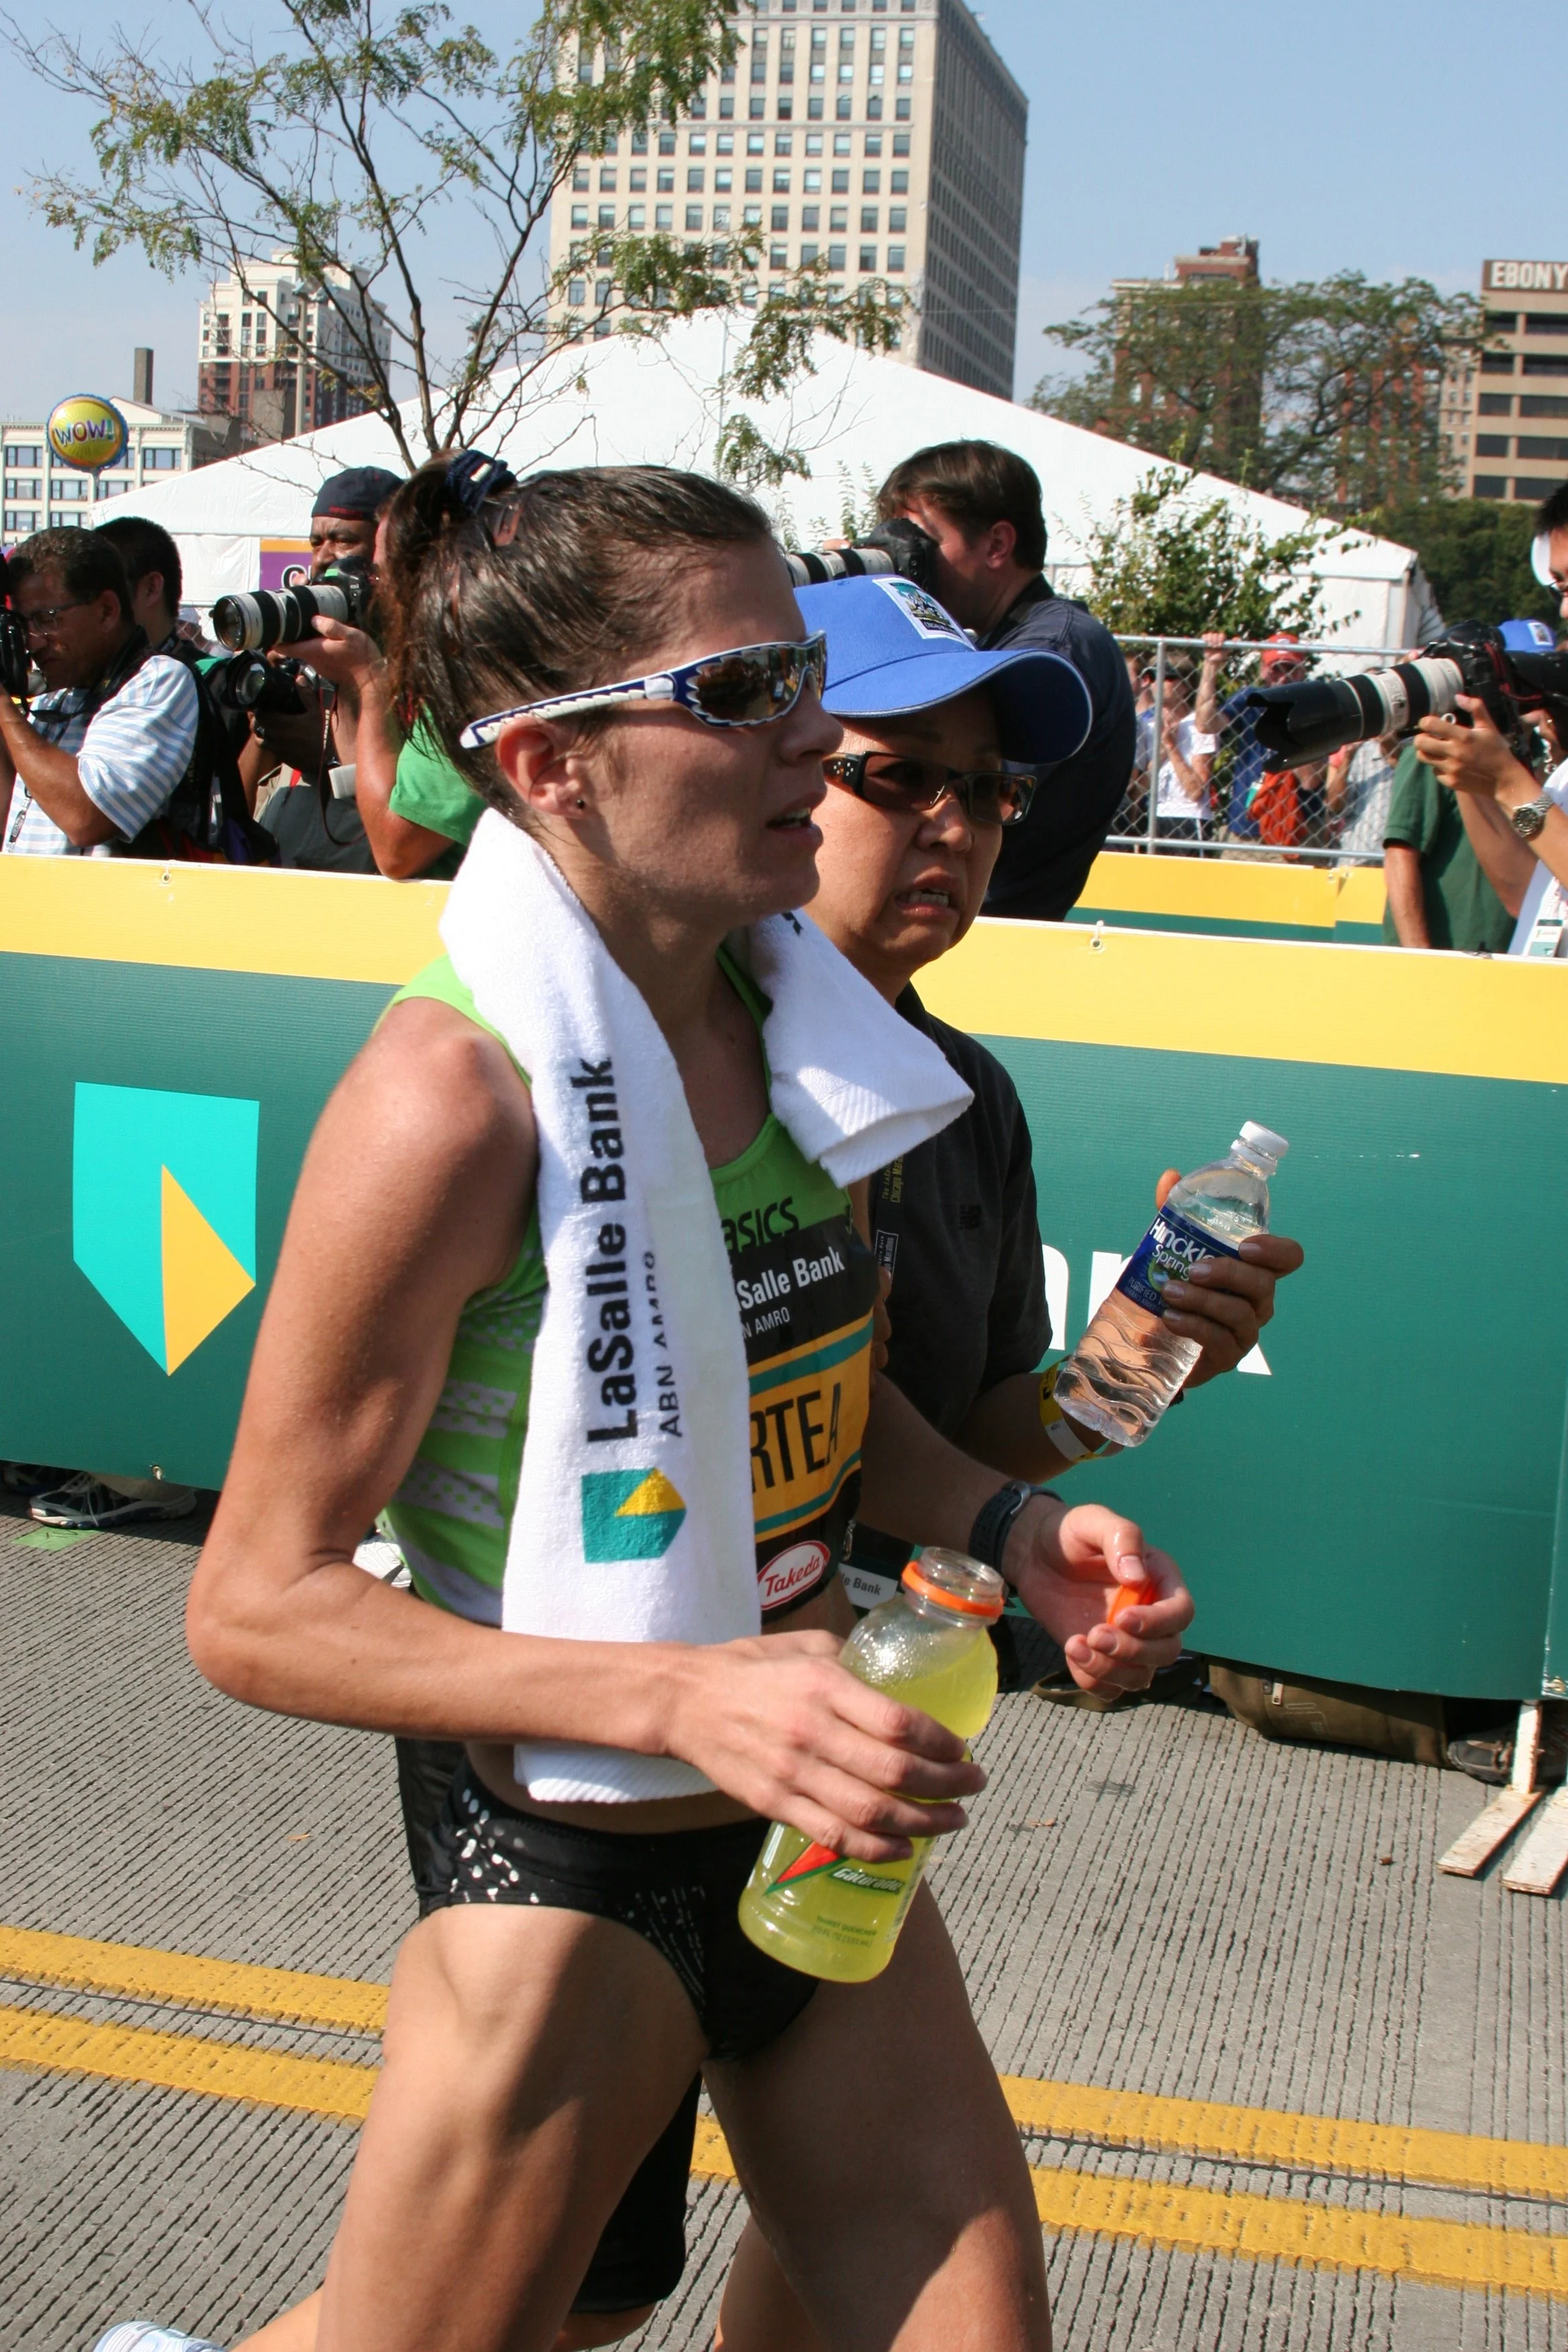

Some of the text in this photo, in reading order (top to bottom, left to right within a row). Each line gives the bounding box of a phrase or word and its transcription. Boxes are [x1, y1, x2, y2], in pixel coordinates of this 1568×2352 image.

[1491, 261, 1568, 289] EBONY
[54, 418, 115, 448] WOW!
[571, 1057, 638, 1442] LaSalle Bank
[737, 1269, 791, 1311] Salle
[793, 1246, 846, 1287] Bank
[755, 1307, 791, 1334] AMRO
[658, 1365, 683, 1438] ABN
[750, 1382, 841, 1493] RTEA
[765, 1555, 821, 1598] Takeda
[852, 1577, 882, 1596] Bank
[832, 1867, 903, 1892] Gatorade
